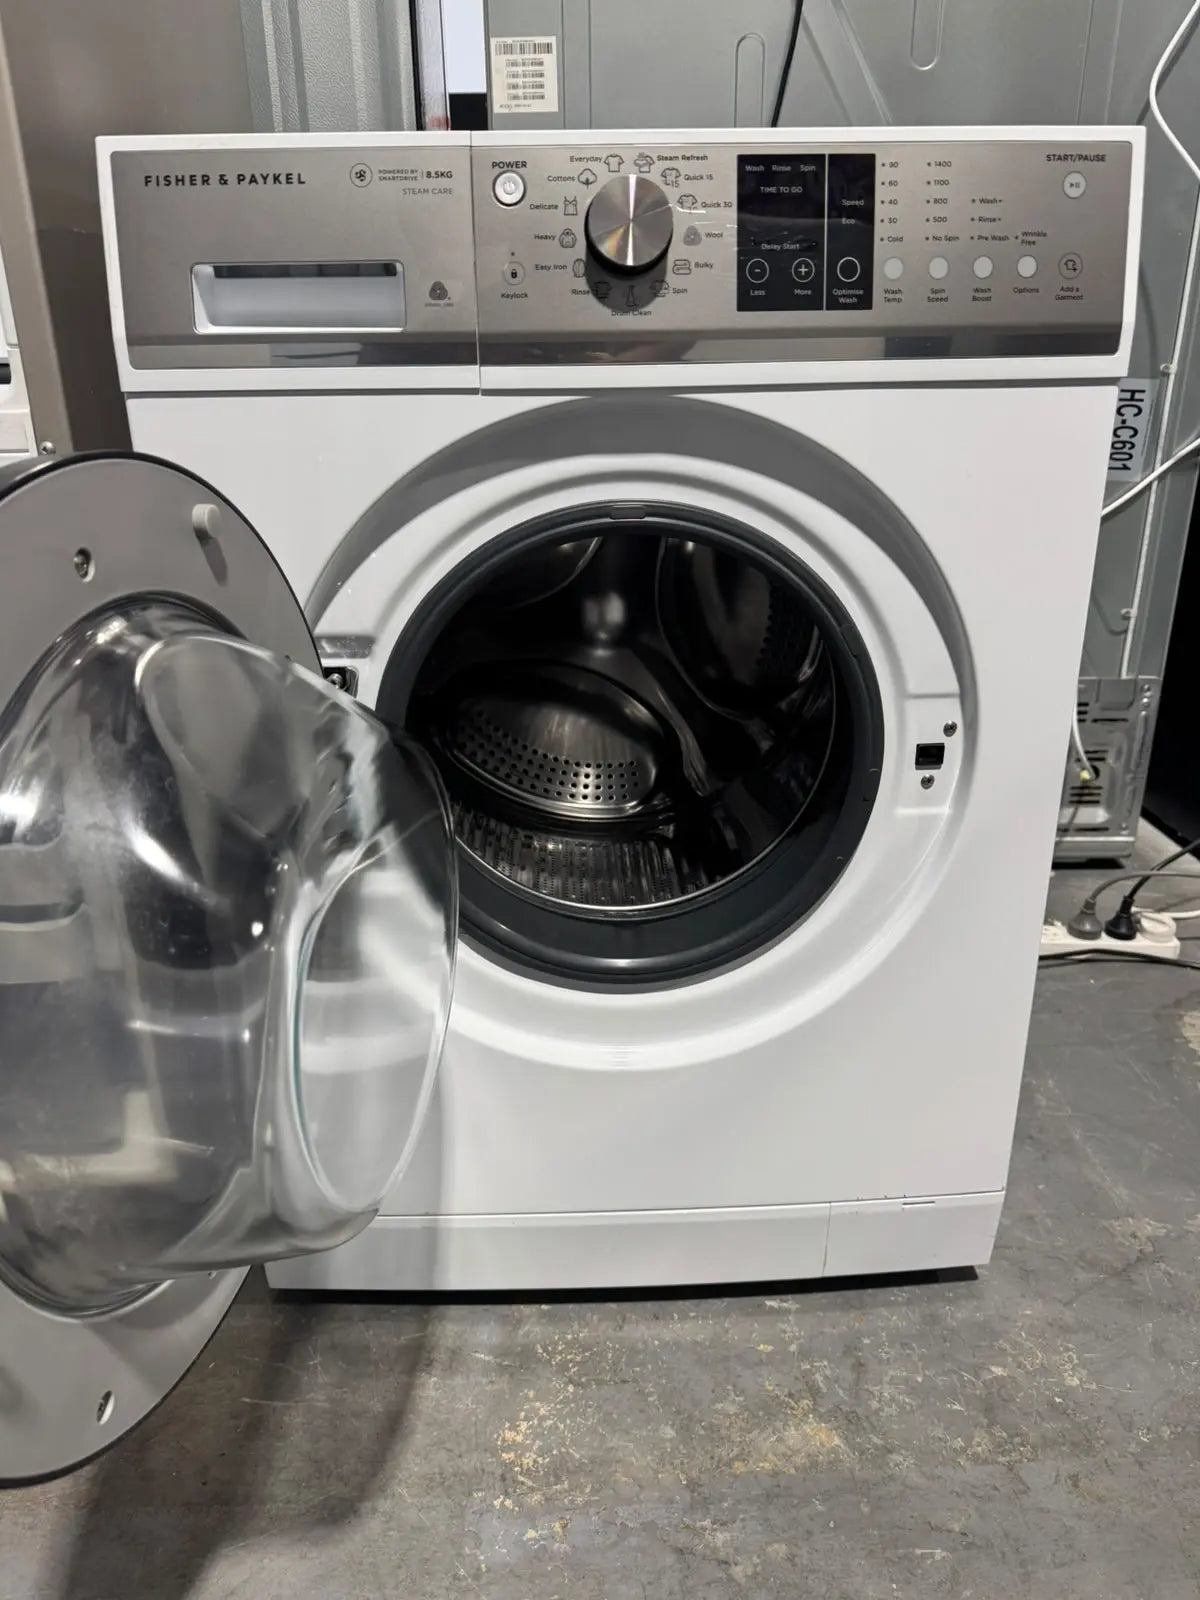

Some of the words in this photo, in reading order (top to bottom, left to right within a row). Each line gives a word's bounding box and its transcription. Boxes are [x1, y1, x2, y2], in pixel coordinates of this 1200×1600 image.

[570, 155, 602, 164] Everyday
[657, 154, 680, 162] Steam
[681, 154, 708, 162] Refresh
[1046, 154, 1106, 163] START/PAUSE
[492, 161, 527, 169] POWER
[800, 164, 816, 173] Spin
[426, 170, 453, 179] 8.5KG
[547, 174, 575, 182] Cottons
[684, 173, 705, 182] Quick
[144, 174, 211, 187] FISHER
[219, 174, 230, 187] &
[237, 173, 306, 185] PAYKEL
[701, 201, 721, 209] Quick
[842, 199, 865, 207] Speed
[534, 234, 556, 242] Heavy
[944, 234, 959, 243] Spin
[535, 264, 552, 272] Easy
[695, 261, 714, 269] Bulky
[571, 288, 590, 296] Rinse
[833, 288, 864, 296] Optimise
[930, 287, 945, 296] Spin
[1013, 286, 1040, 295] Options
[501, 292, 528, 300] Keylock
[927, 295, 948, 303] Speed
[1055, 293, 1083, 301] Garment
[1107, 388, 1146, 472] HC-C601
